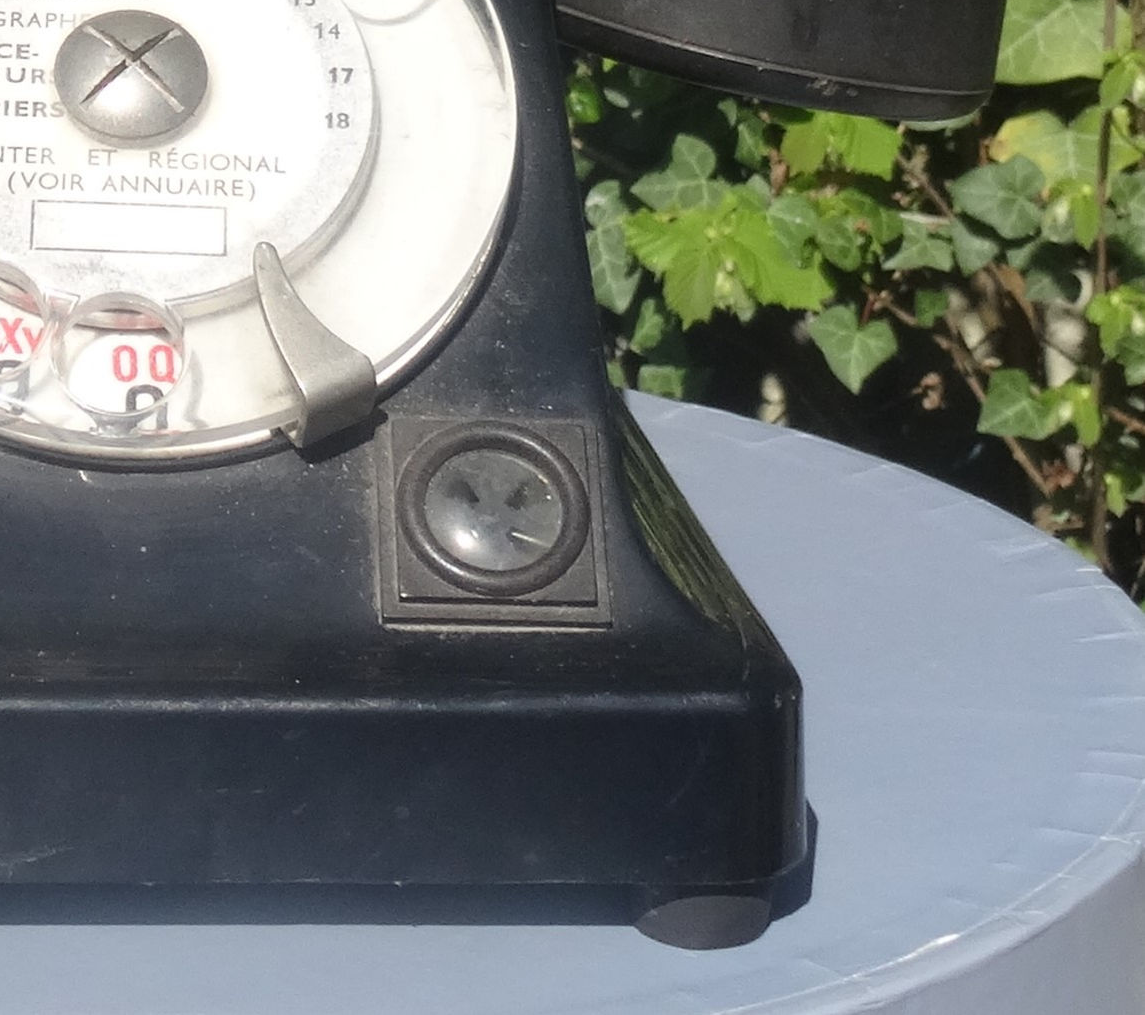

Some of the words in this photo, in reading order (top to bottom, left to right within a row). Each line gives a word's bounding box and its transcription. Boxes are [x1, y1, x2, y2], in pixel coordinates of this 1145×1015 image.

[314, 22, 340, 39] 14
[329, 67, 354, 84] 17
[325, 112, 350, 129] 18
[87, 149, 117, 166] ET
[148, 147, 287, 174] RÉGIONAL
[7, 171, 84, 195] (VOIR
[102, 176, 256, 202] ANNUAIRE)
